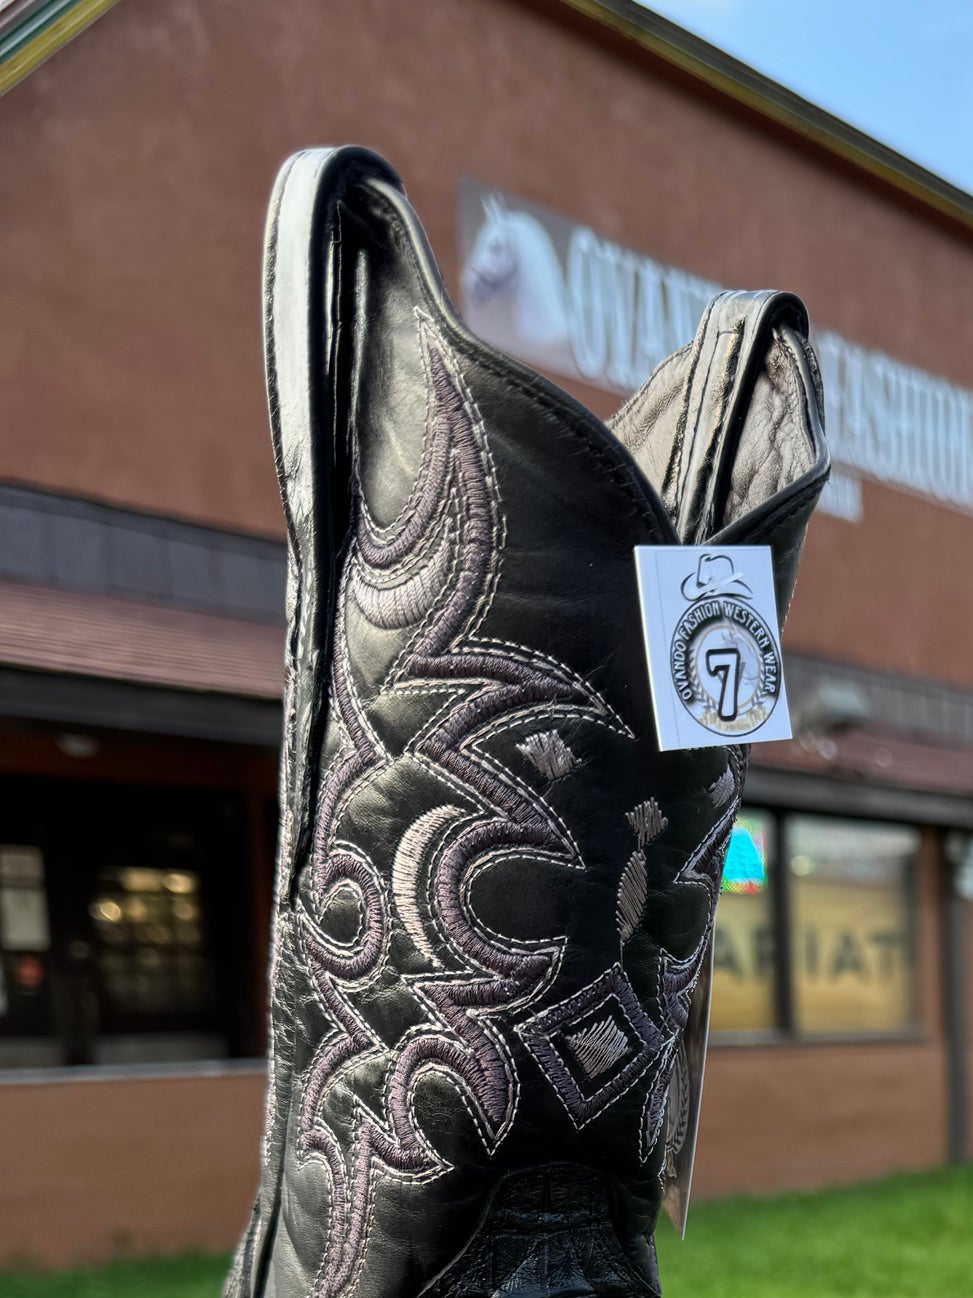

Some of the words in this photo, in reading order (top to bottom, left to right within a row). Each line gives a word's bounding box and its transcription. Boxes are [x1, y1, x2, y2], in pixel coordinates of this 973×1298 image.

[678, 600, 721, 641] FASHION
[722, 600, 770, 650] WESTERN
[674, 642, 692, 701] OVANDO
[706, 648, 741, 722] 7
[763, 651, 777, 695] WEAR
